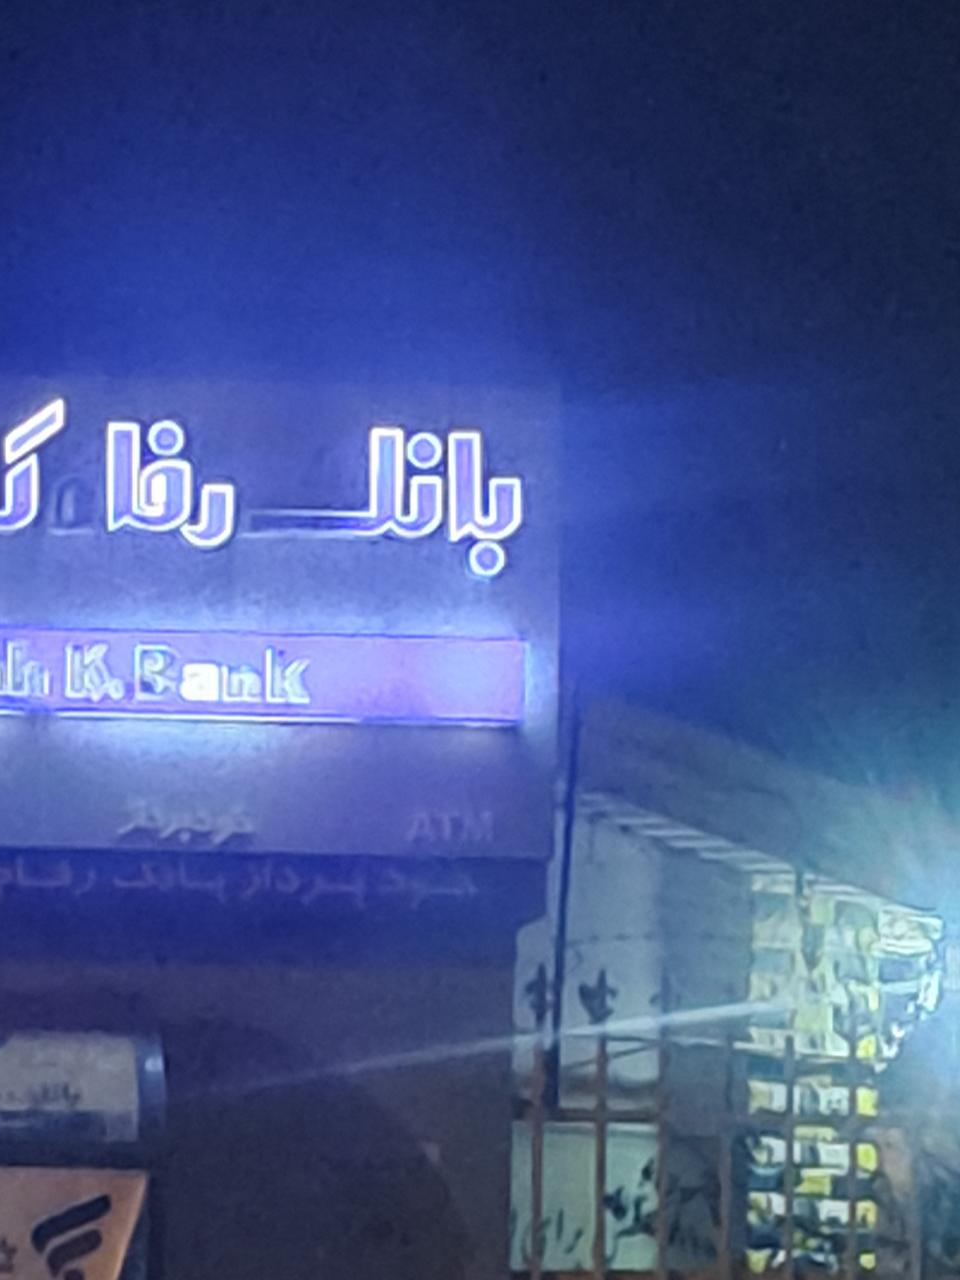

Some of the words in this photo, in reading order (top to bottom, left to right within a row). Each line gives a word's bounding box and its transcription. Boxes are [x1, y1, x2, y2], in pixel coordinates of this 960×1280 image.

[64, 642, 126, 703] K.
[132, 642, 314, 706] Bank
[404, 808, 496, 843] ATM
